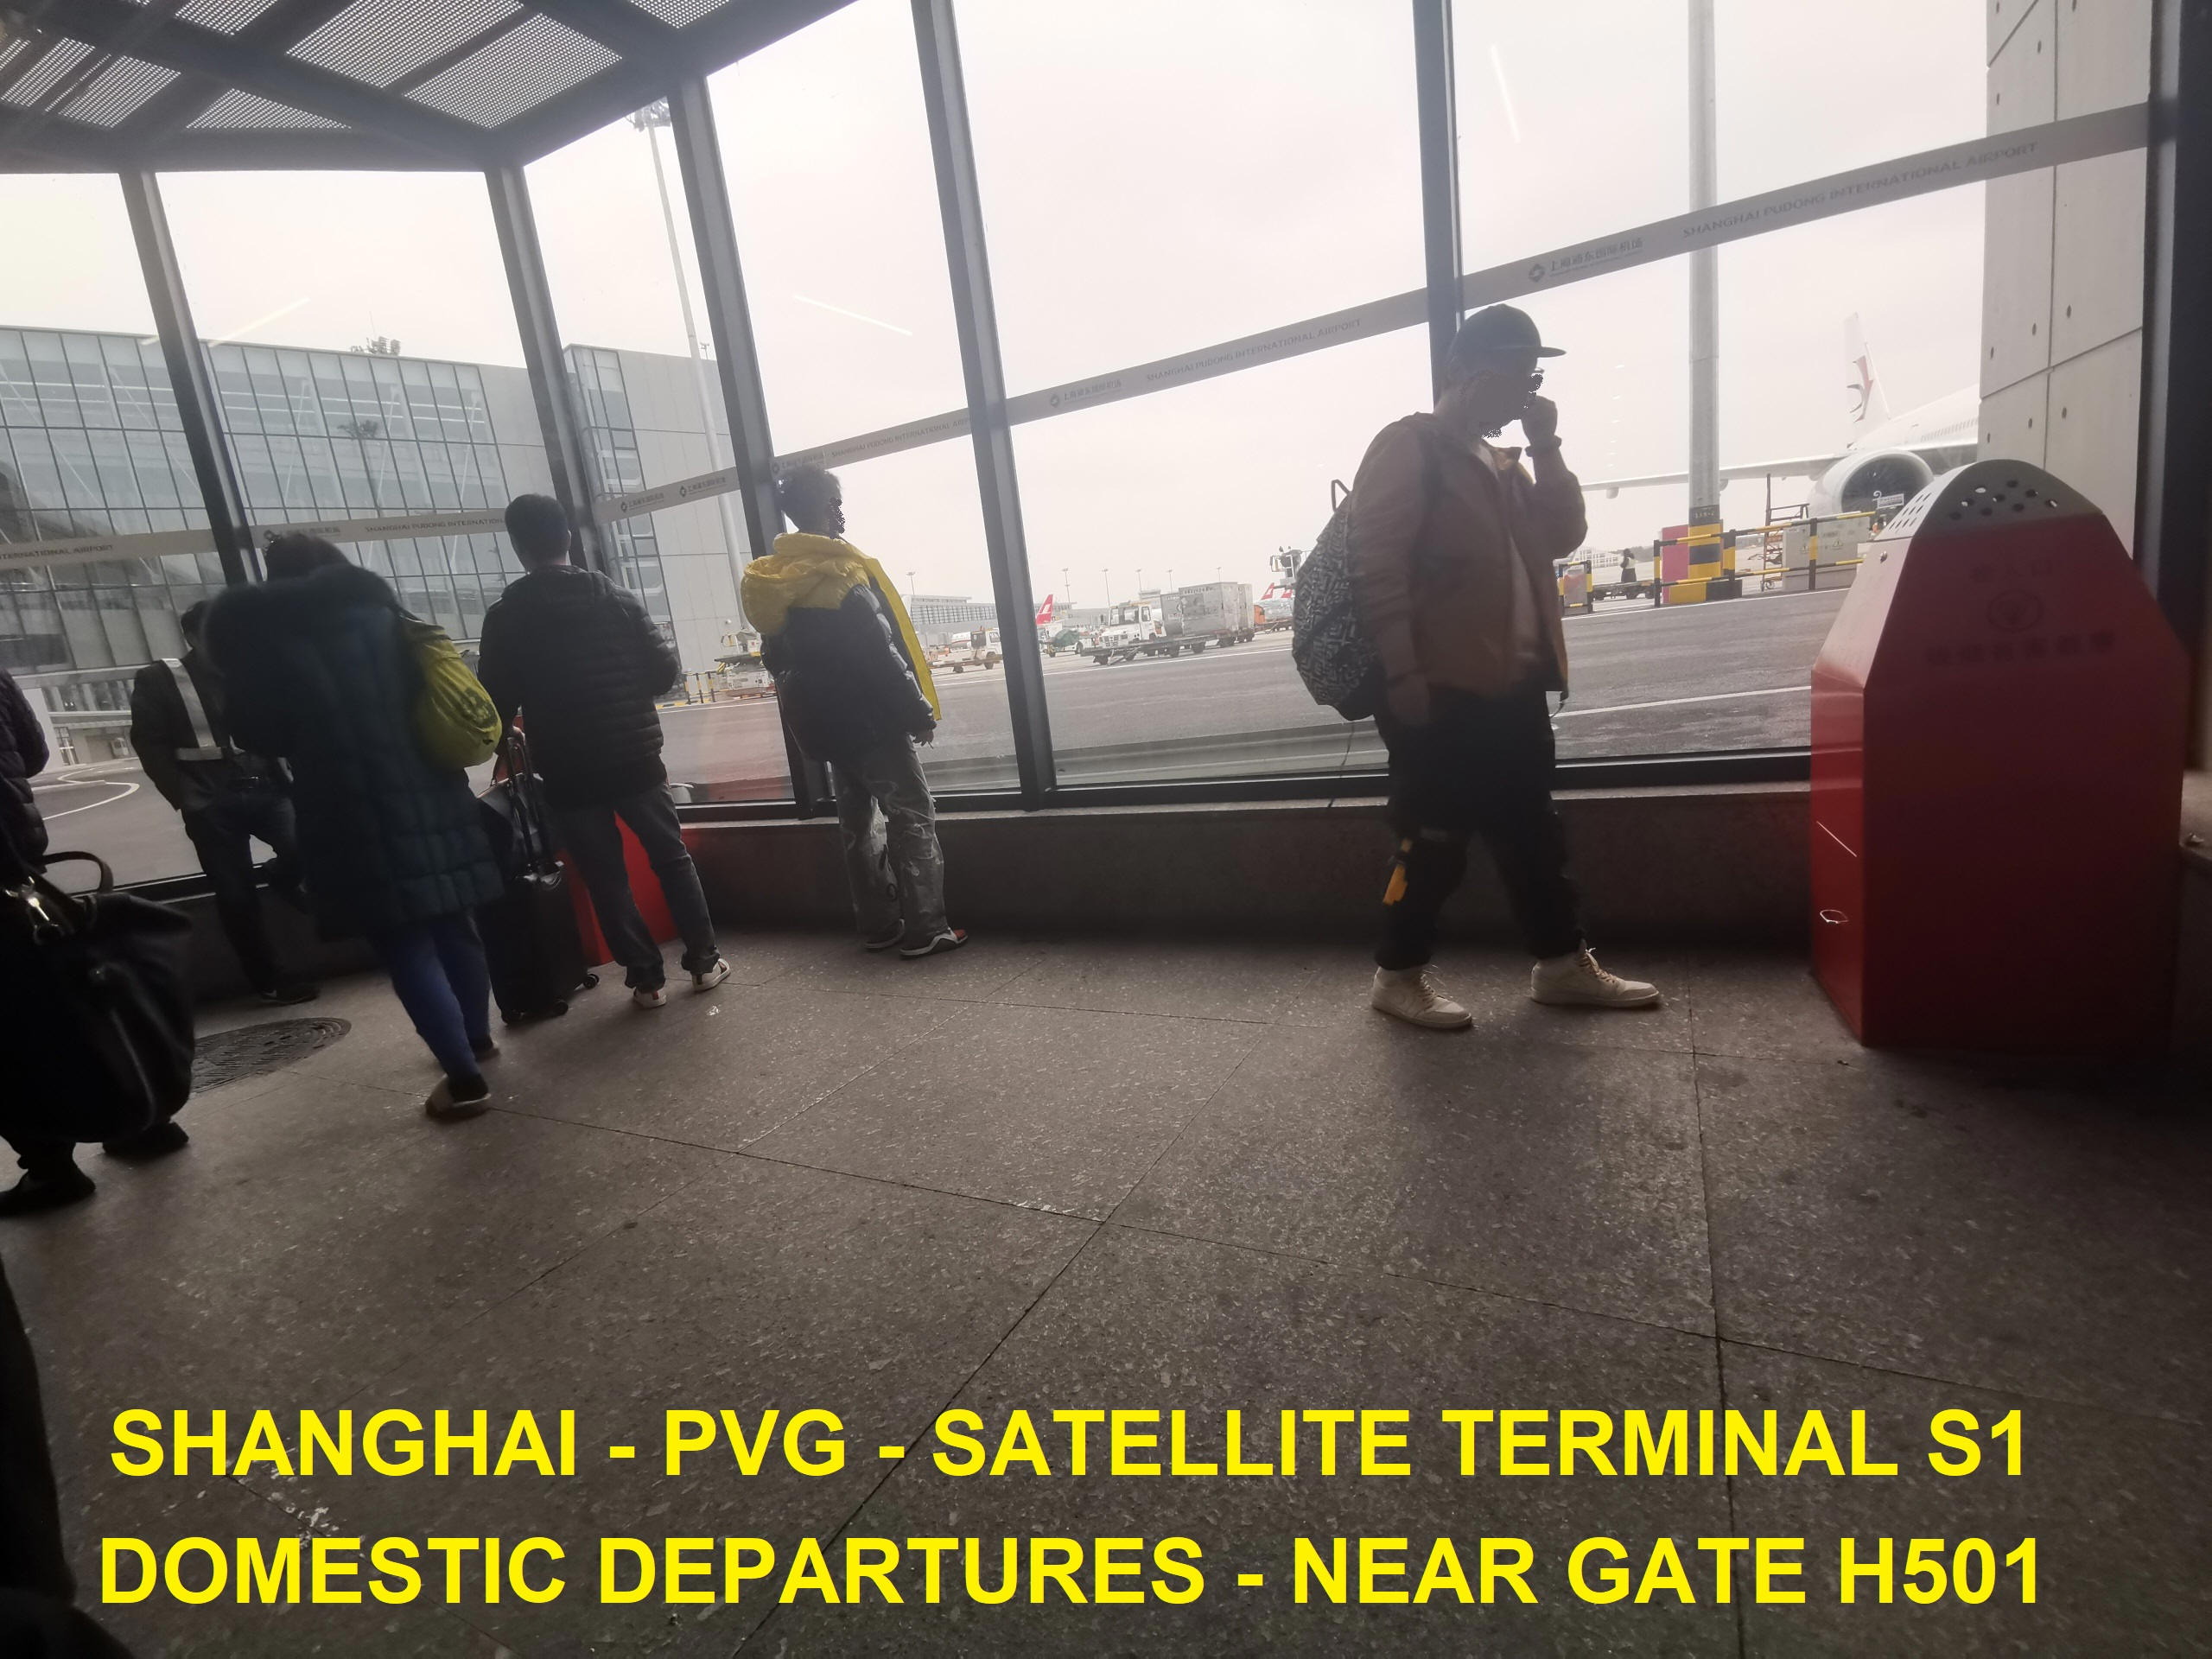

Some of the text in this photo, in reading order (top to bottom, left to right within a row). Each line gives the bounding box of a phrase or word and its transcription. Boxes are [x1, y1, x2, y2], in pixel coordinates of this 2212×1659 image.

[1682, 141, 2040, 238] SHANGHAI PUDONG INTERNATIONAL AIRPORT
[1147, 318, 1362, 381] SHANGHAI PUDONG INTERNATIONAL AIRPORT
[365, 524, 411, 533] SHANGHAI
[412, 521, 448, 531] PUDONG
[73, 543, 113, 554] AIRPORT
